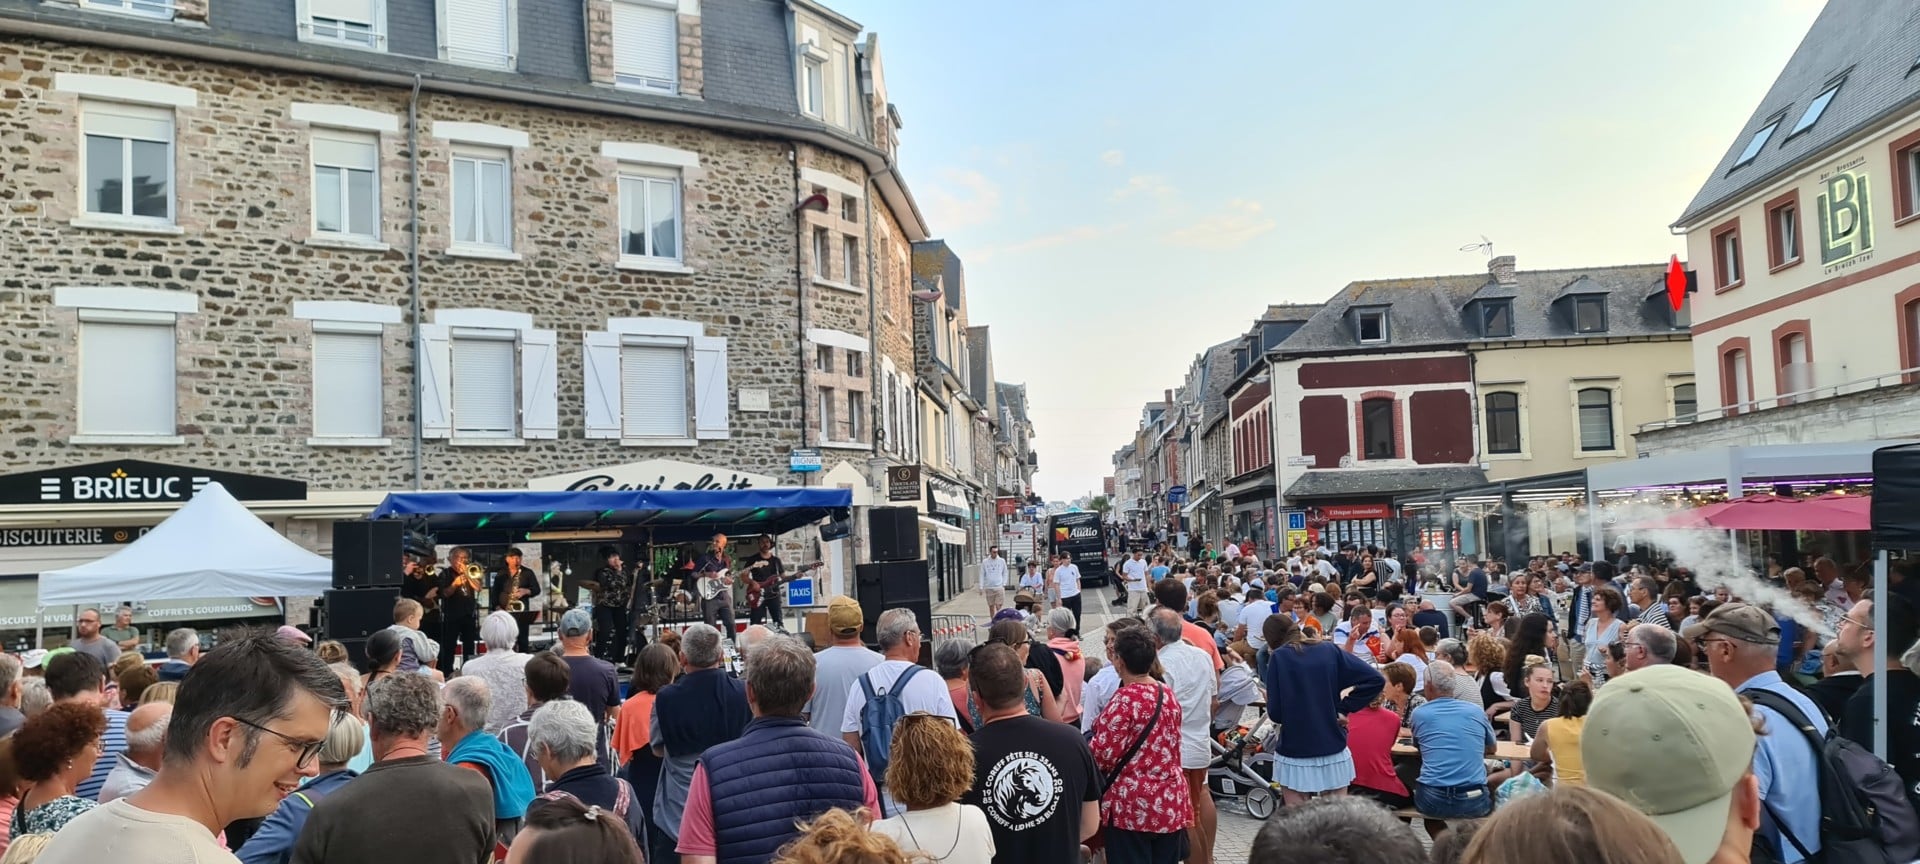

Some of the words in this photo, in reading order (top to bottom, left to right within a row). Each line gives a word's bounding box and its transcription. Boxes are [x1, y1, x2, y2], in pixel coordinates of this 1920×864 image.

[71, 476, 181, 499] BRIEUC
[790, 587, 811, 597] TAXIS
[148, 607, 194, 617] COFFRETS
[195, 604, 254, 614] GOURMANDS
[985, 758, 1006, 788] COREFF
[1024, 751, 1039, 760] SES
[982, 789, 992, 797] 19
